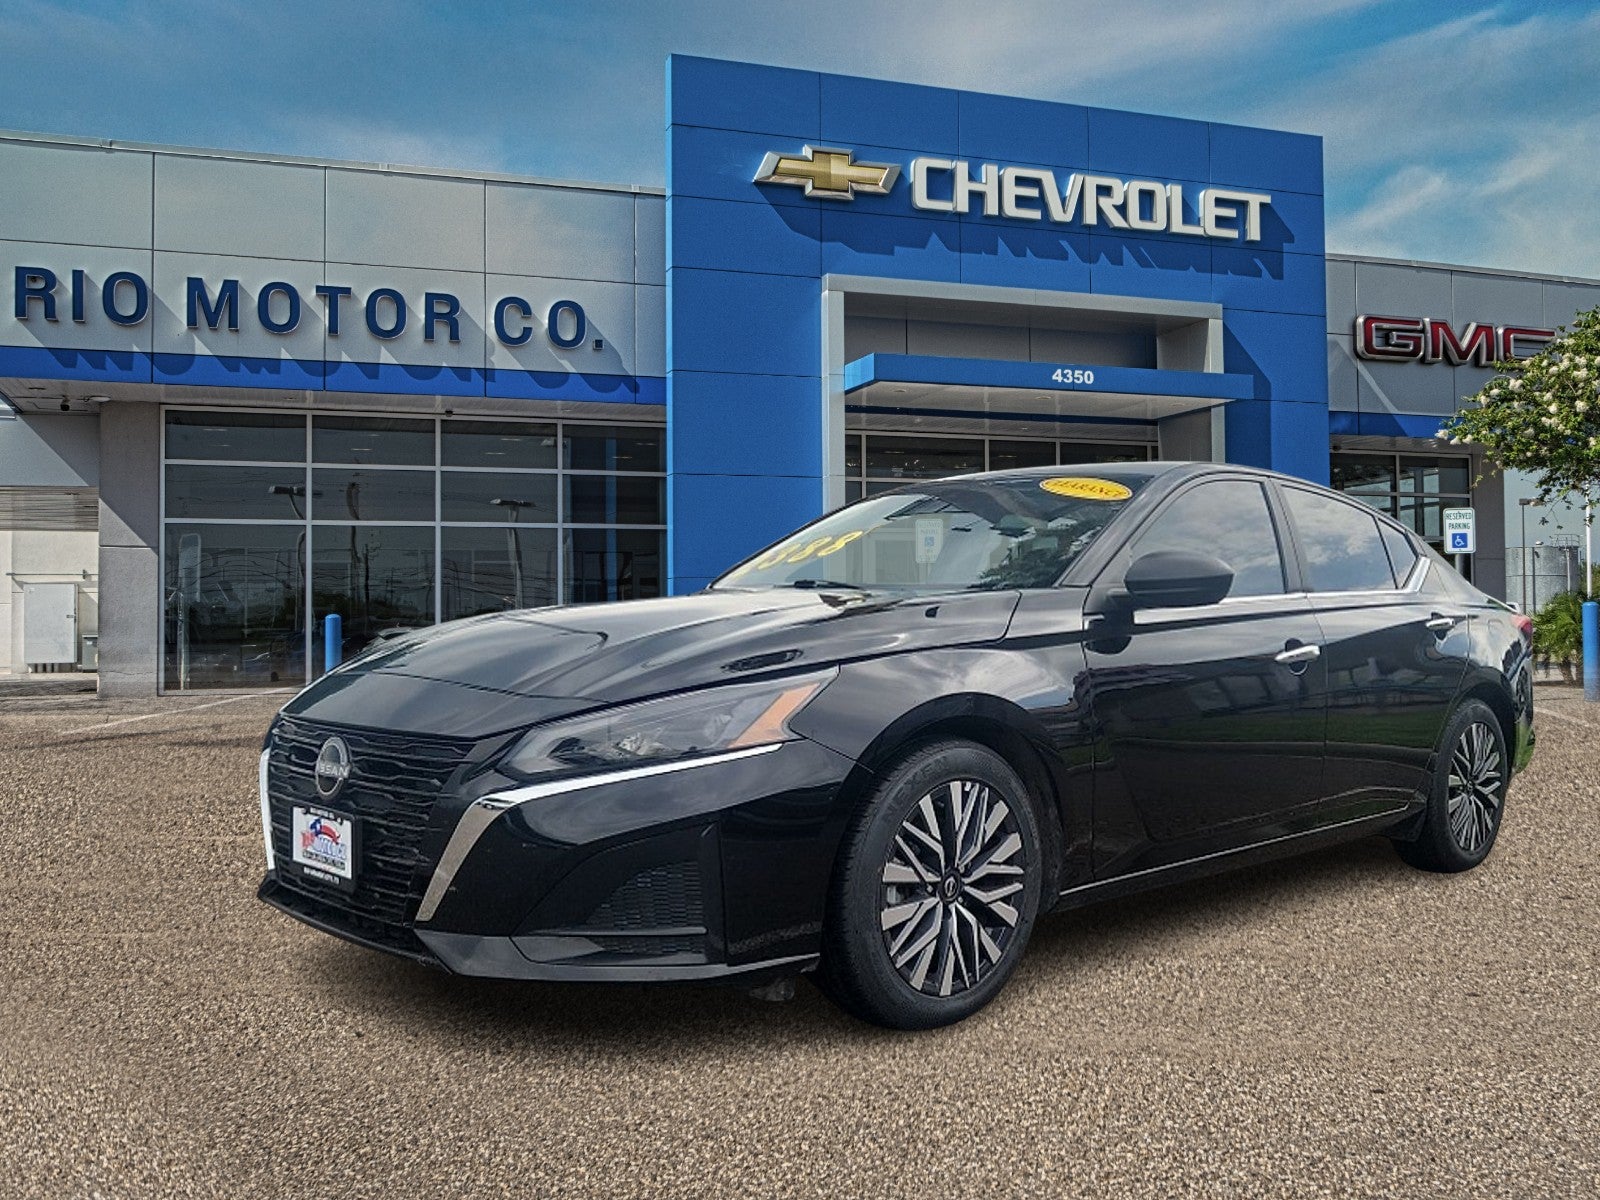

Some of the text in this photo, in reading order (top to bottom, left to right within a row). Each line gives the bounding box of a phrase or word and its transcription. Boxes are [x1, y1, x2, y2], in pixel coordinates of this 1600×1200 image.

[910, 157, 1272, 242] CHEVROLET
[14, 265, 604, 350] RIO MOTOR CO.
[1356, 313, 1557, 367] GMC
[1051, 368, 1095, 385] 4350
[1445, 512, 1472, 520] RESERVED
[1448, 522, 1471, 530] PARKING
